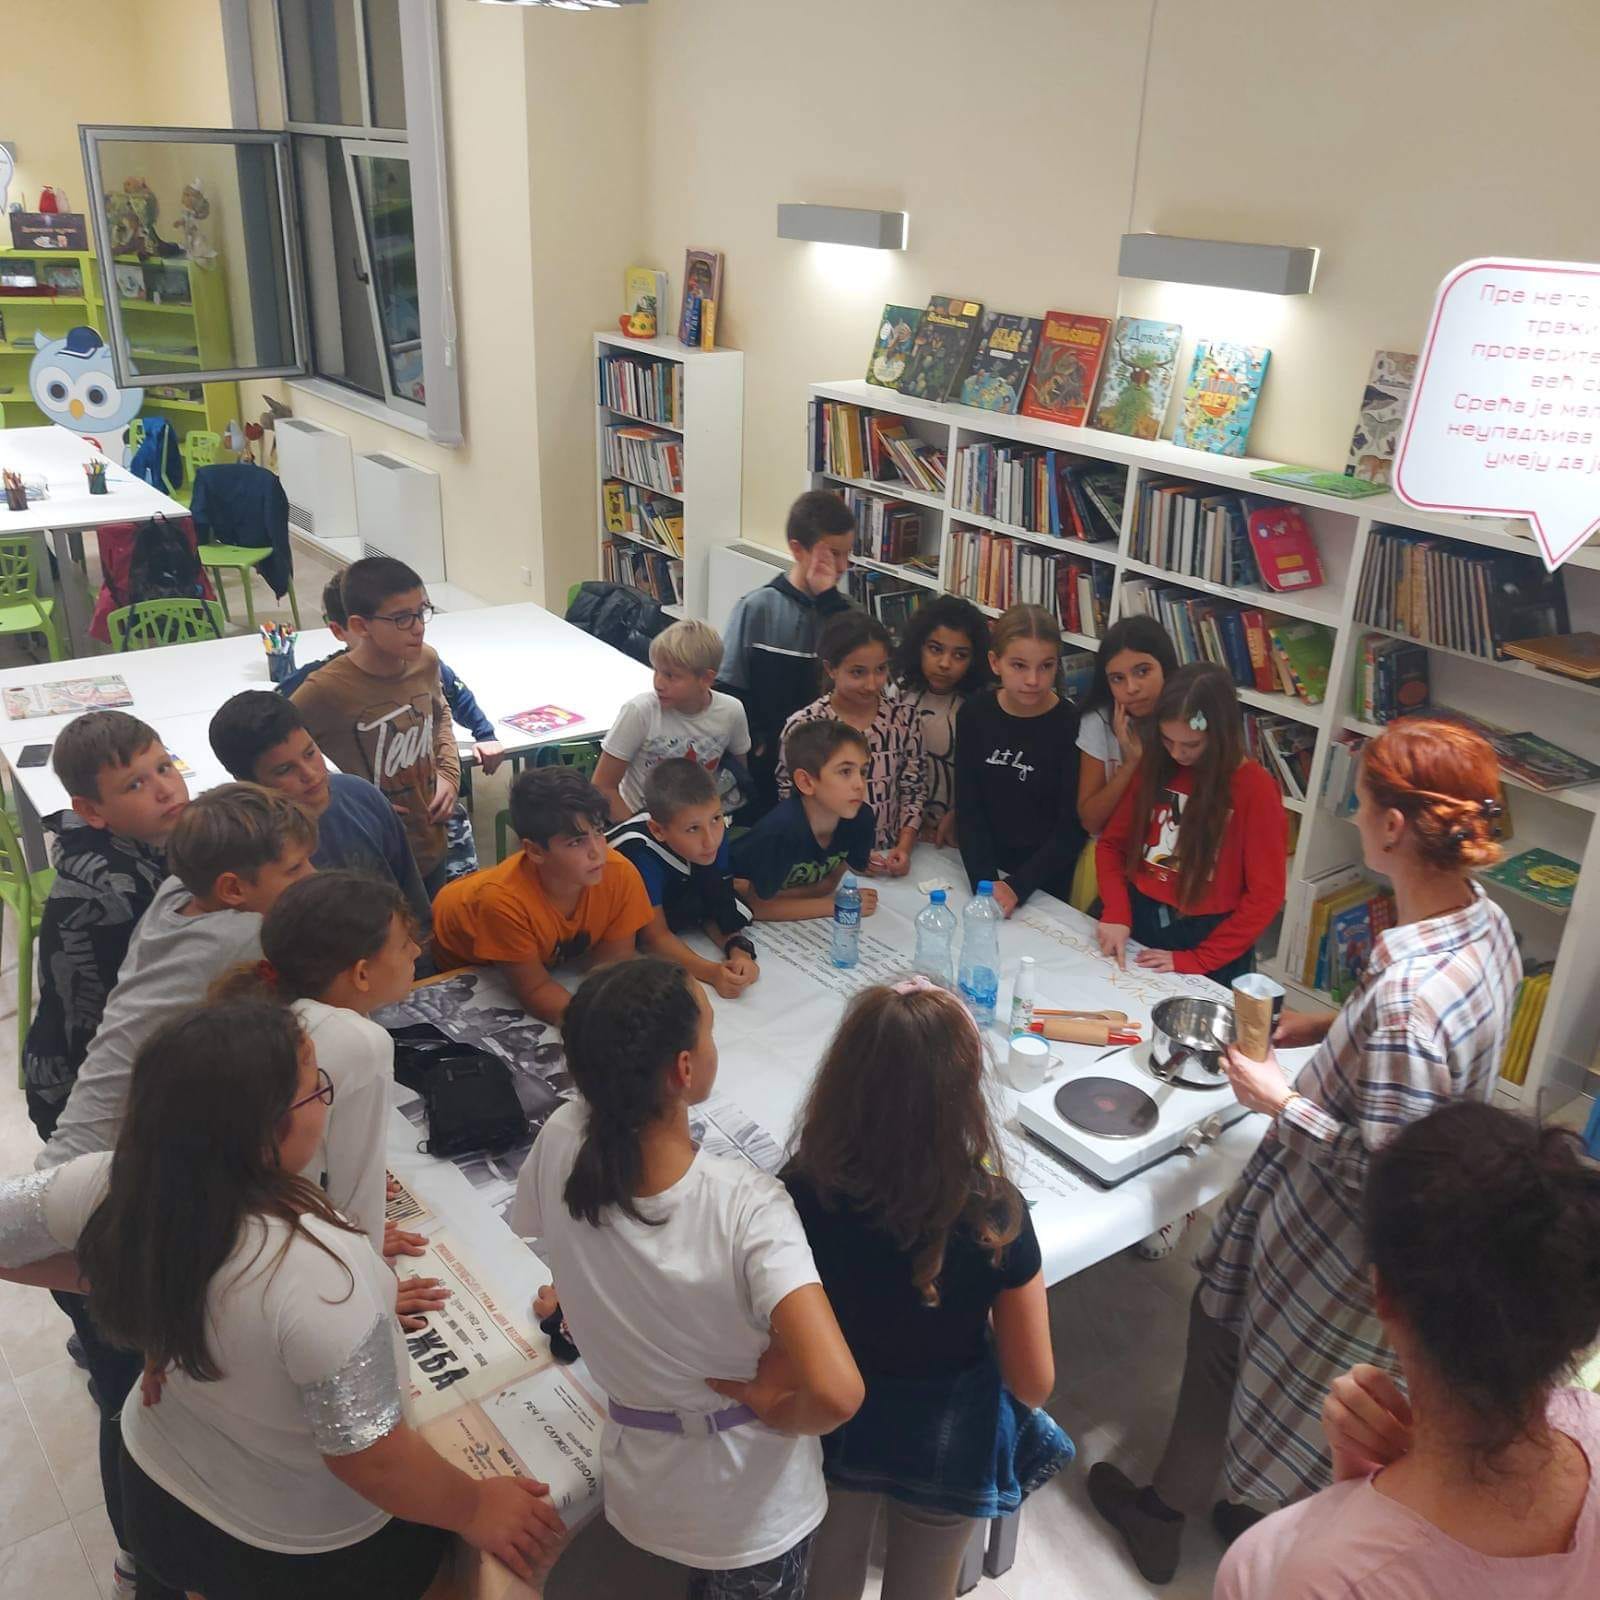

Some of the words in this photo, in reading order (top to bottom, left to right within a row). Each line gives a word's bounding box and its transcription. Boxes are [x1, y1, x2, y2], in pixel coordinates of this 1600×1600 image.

[1480, 284, 1525, 306] Пре
[1533, 291, 1590, 308] него
[1530, 374, 1574, 390] већ
[1453, 392, 1527, 414] Срећа
[1529, 398, 1553, 418] је
[1447, 423, 1594, 446] неупадљива
[1484, 450, 1551, 473] умеју
[1556, 456, 1584, 471] да
[523, 1399, 539, 1417] РЕЧ
[543, 1422, 572, 1458] СЛУЖБИ
